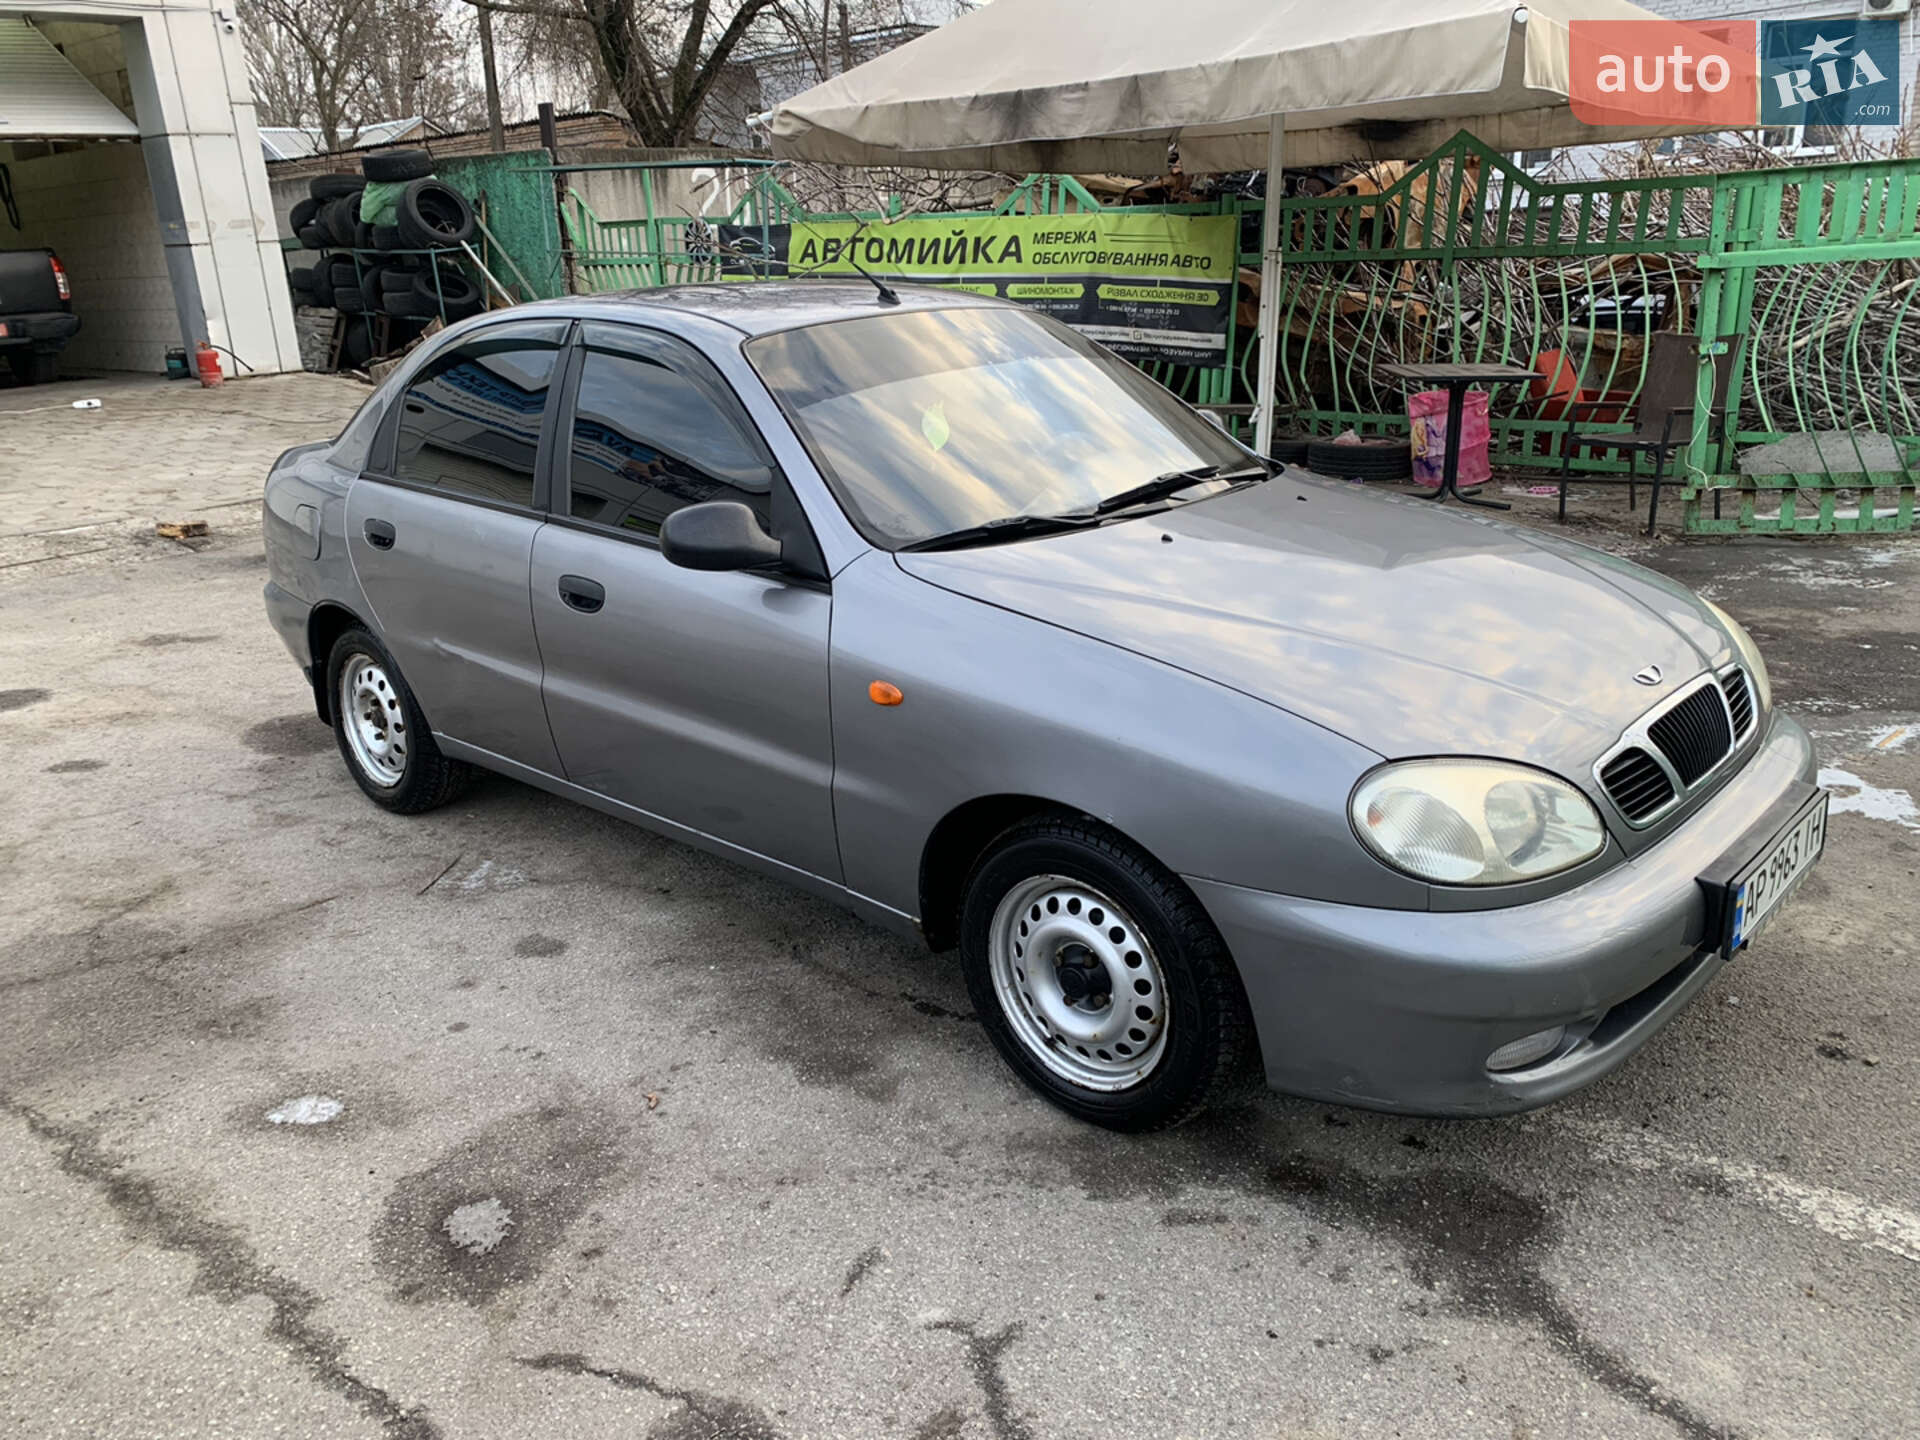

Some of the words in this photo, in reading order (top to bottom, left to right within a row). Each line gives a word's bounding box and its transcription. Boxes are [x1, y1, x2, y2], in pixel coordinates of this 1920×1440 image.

[800, 229, 1023, 264] АВТОМИЙКА
[1032, 230, 1097, 245] МЕРЕЖА
[1032, 250, 1169, 267] ОБСЛУГОВУВАННЯ
[1170, 254, 1212, 270] АВТО
[1744, 868, 1767, 927] AP
[1769, 830, 1801, 898] 9963
[1804, 806, 1823, 858] IH
